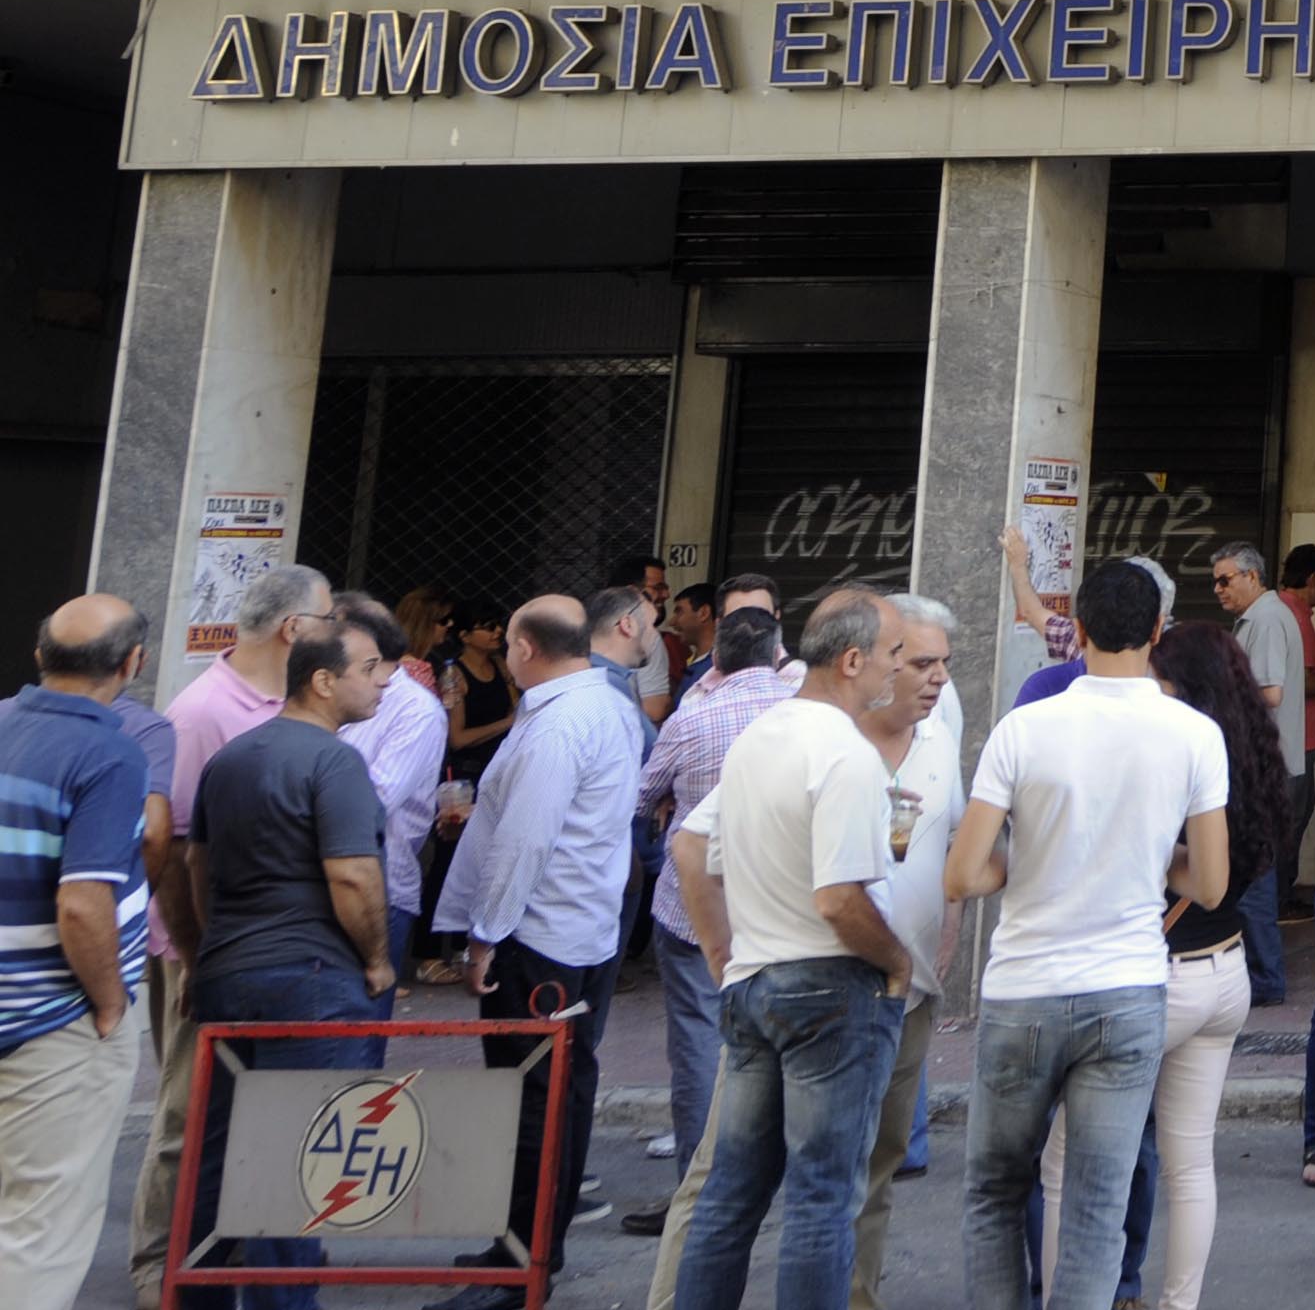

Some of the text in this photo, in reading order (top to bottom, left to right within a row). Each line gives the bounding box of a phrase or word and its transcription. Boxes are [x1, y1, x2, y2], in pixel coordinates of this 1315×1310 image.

[190, 1, 730, 100] ΔΗΜΟΣΙΑ
[670, 545, 697, 567] 30
[190, 627, 237, 642] ΞΥΠΝ
[308, 1108, 408, 1197] ΔΕΗ
